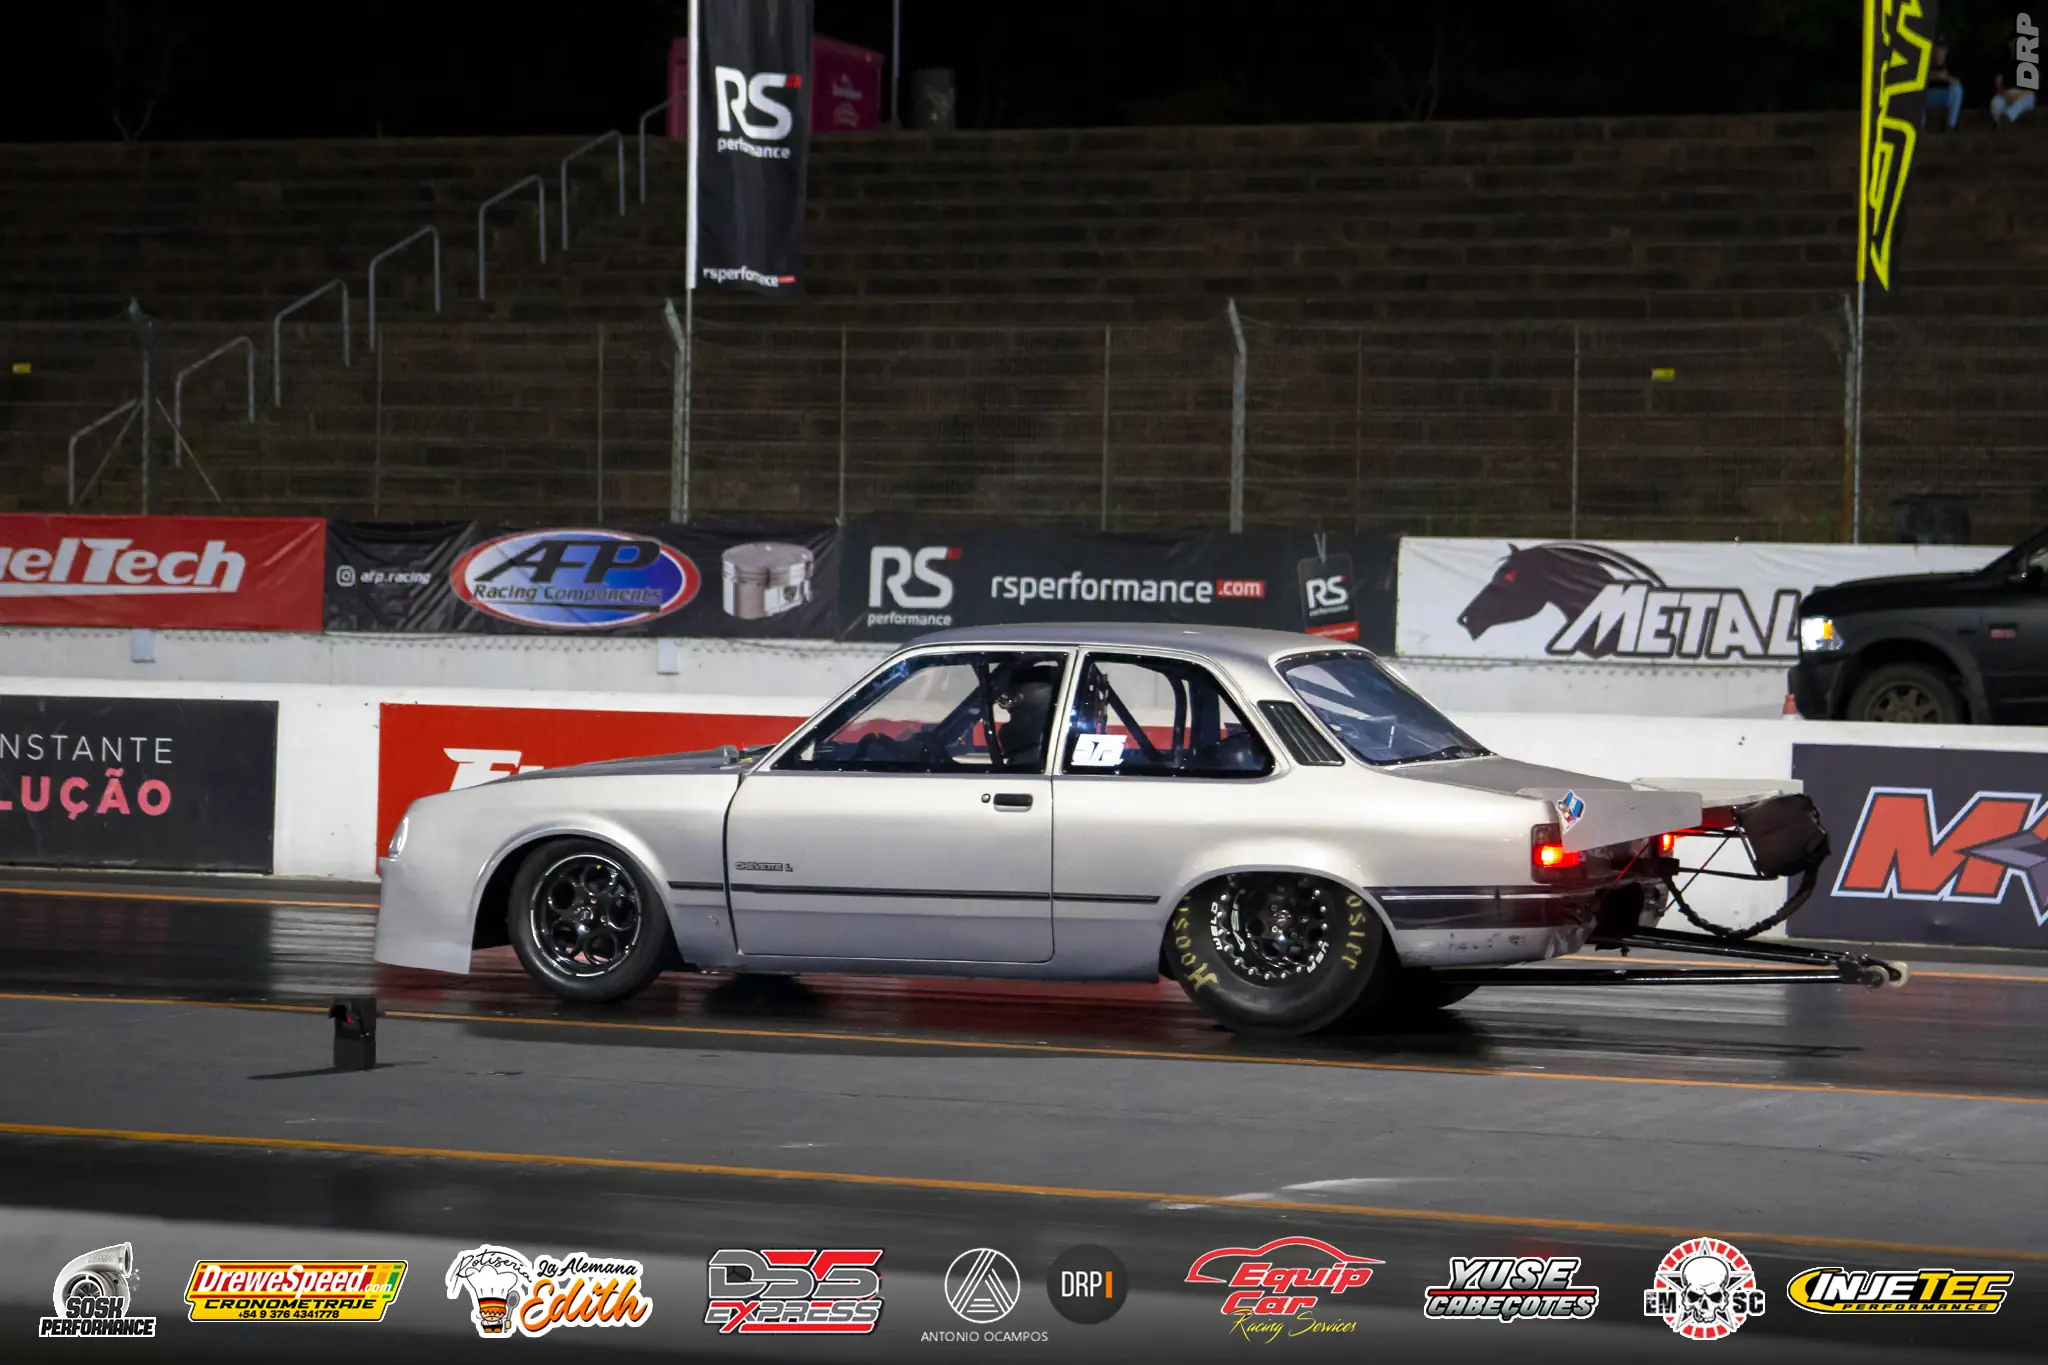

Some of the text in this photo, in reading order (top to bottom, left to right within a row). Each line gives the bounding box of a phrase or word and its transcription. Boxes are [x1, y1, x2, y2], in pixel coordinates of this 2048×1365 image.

[715, 66, 793, 140] RS
[474, 540, 661, 583] AFP
[869, 546, 954, 609] RS
[473, 584, 663, 604] Racing Components
[1306, 575, 1349, 609] RS
[867, 612, 952, 627] performance
